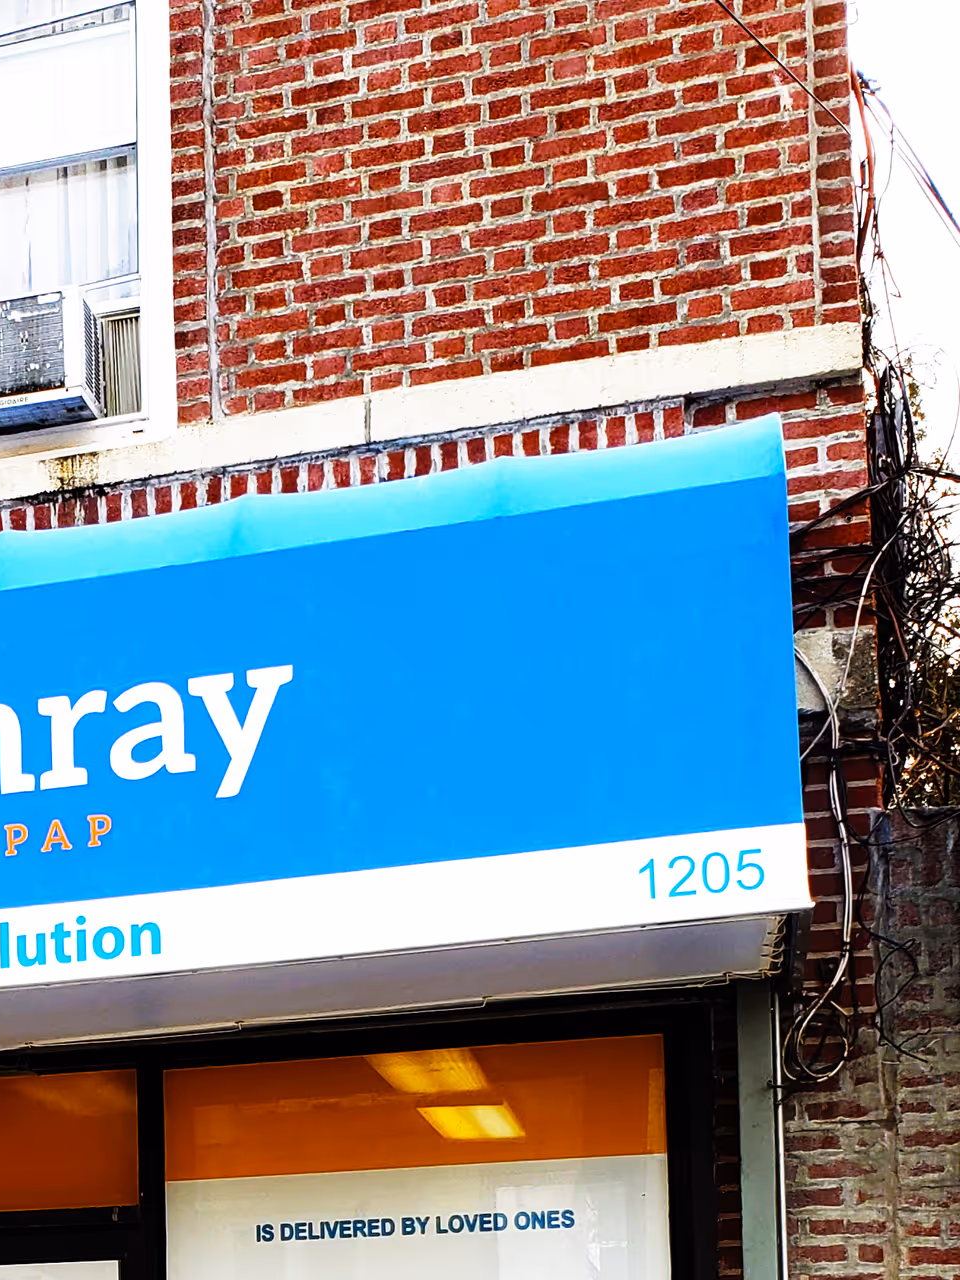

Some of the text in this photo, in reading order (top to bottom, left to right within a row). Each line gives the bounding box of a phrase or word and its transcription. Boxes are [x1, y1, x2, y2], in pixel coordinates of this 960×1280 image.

[639, 849, 764, 899] 1205
[256, 1210, 574, 1242] IS DELIVERED BY LOVED ONES
